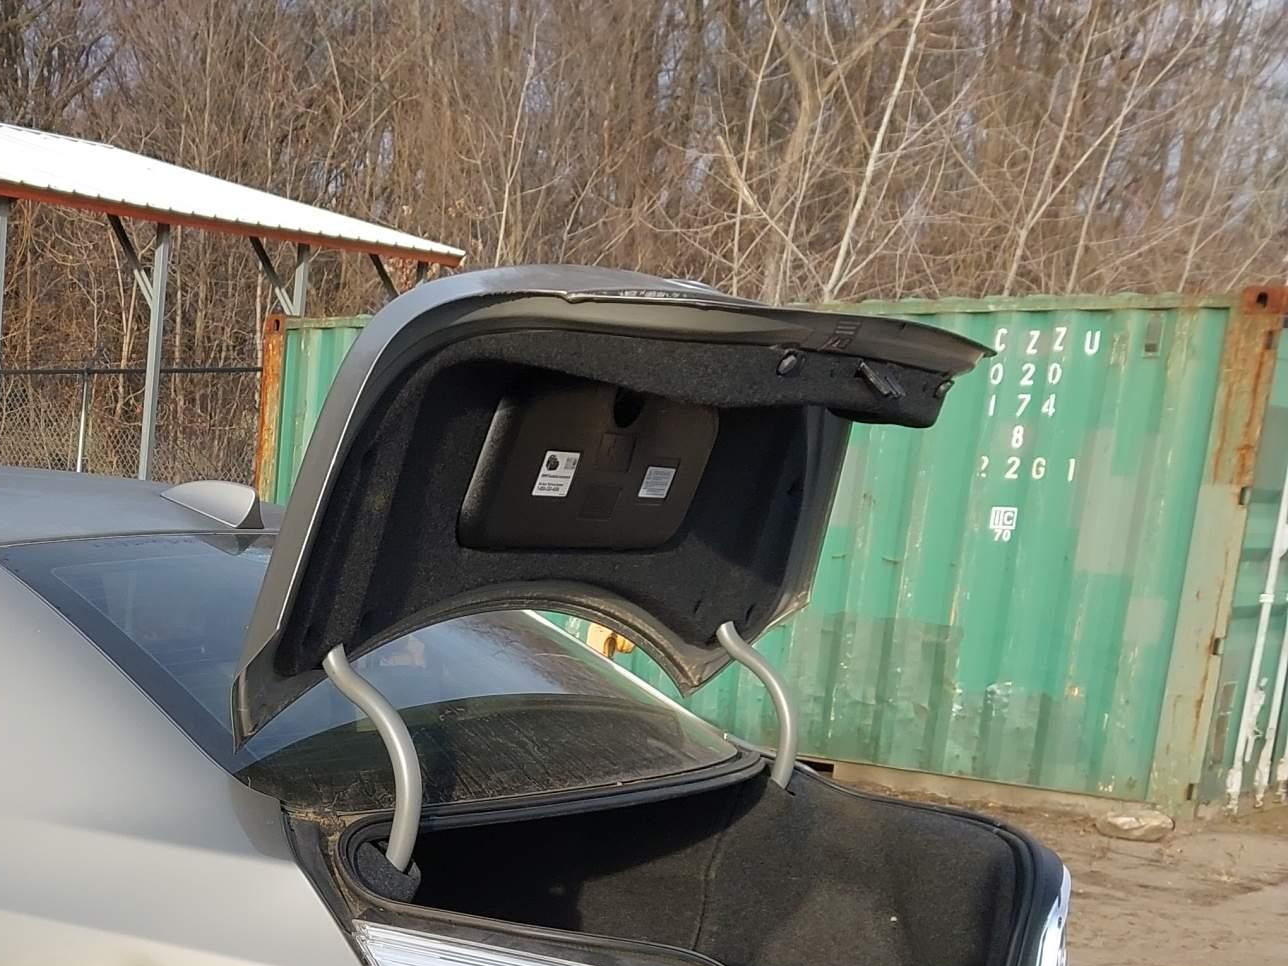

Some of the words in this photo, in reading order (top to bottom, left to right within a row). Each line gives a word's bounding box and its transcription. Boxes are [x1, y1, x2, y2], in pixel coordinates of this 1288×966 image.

[990, 362, 1062, 386] 020
[988, 393, 1056, 417] 174
[1011, 425, 1024, 448] 8
[994, 529, 1011, 542] 70
